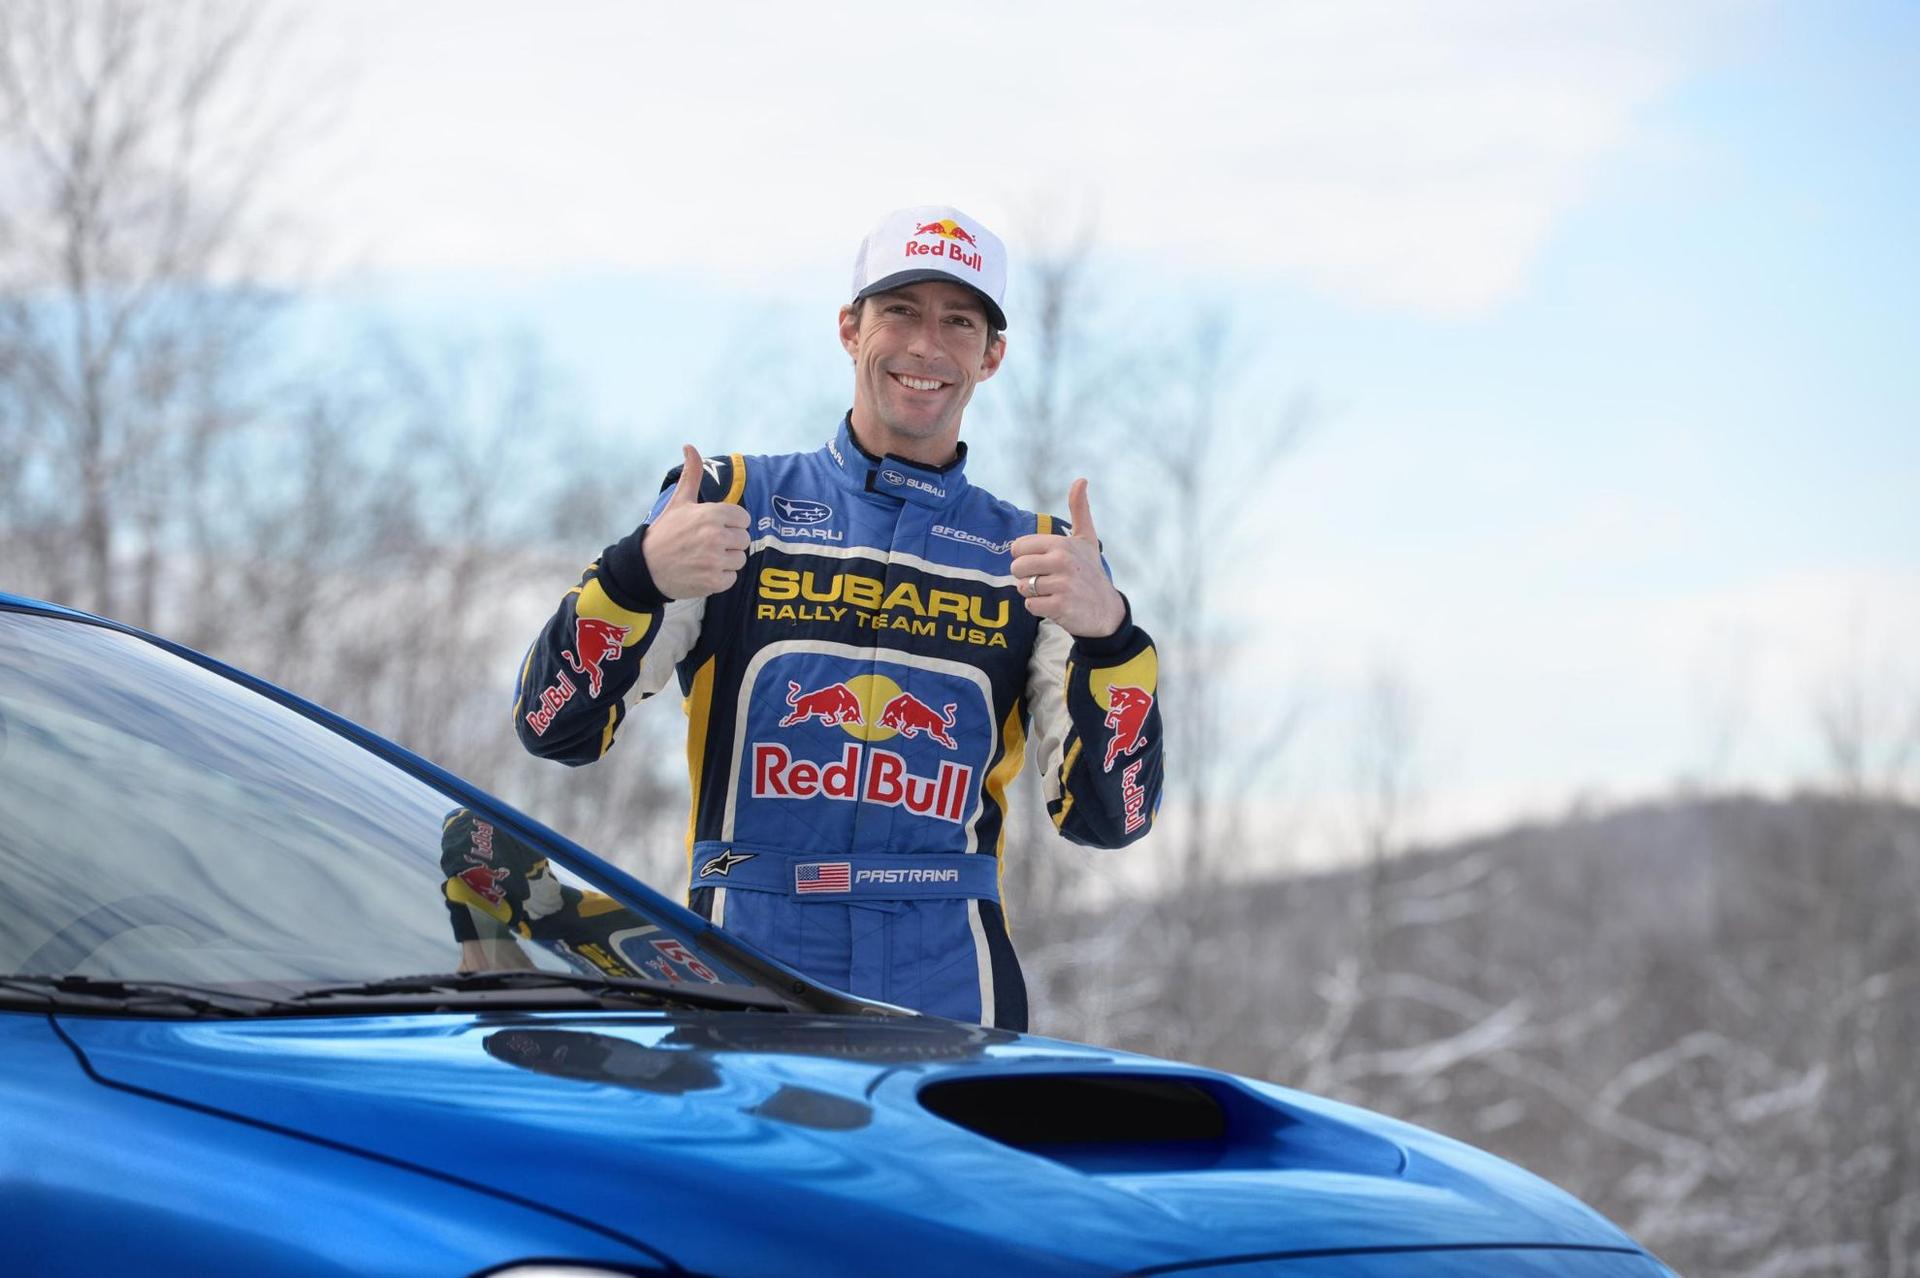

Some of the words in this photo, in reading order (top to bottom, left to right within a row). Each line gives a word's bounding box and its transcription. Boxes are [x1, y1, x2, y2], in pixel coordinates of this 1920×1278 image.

[905, 240, 945, 257] Red
[949, 243, 982, 272] Bull
[906, 478, 946, 498] SUBAU
[757, 516, 843, 541] SUBARU
[931, 525, 1014, 552] BFGoodric
[758, 567, 1009, 629] SUBARU
[757, 604, 848, 621] RALLY
[856, 610, 936, 637] TEAM
[947, 624, 1008, 649] USA
[525, 694, 555, 736] Red
[545, 669, 577, 711] Bull
[752, 742, 863, 800] Red
[863, 748, 973, 825] Bull
[1122, 759, 1145, 800] Red
[1124, 795, 1146, 834] Bull
[855, 869, 958, 884] PASTRANA
